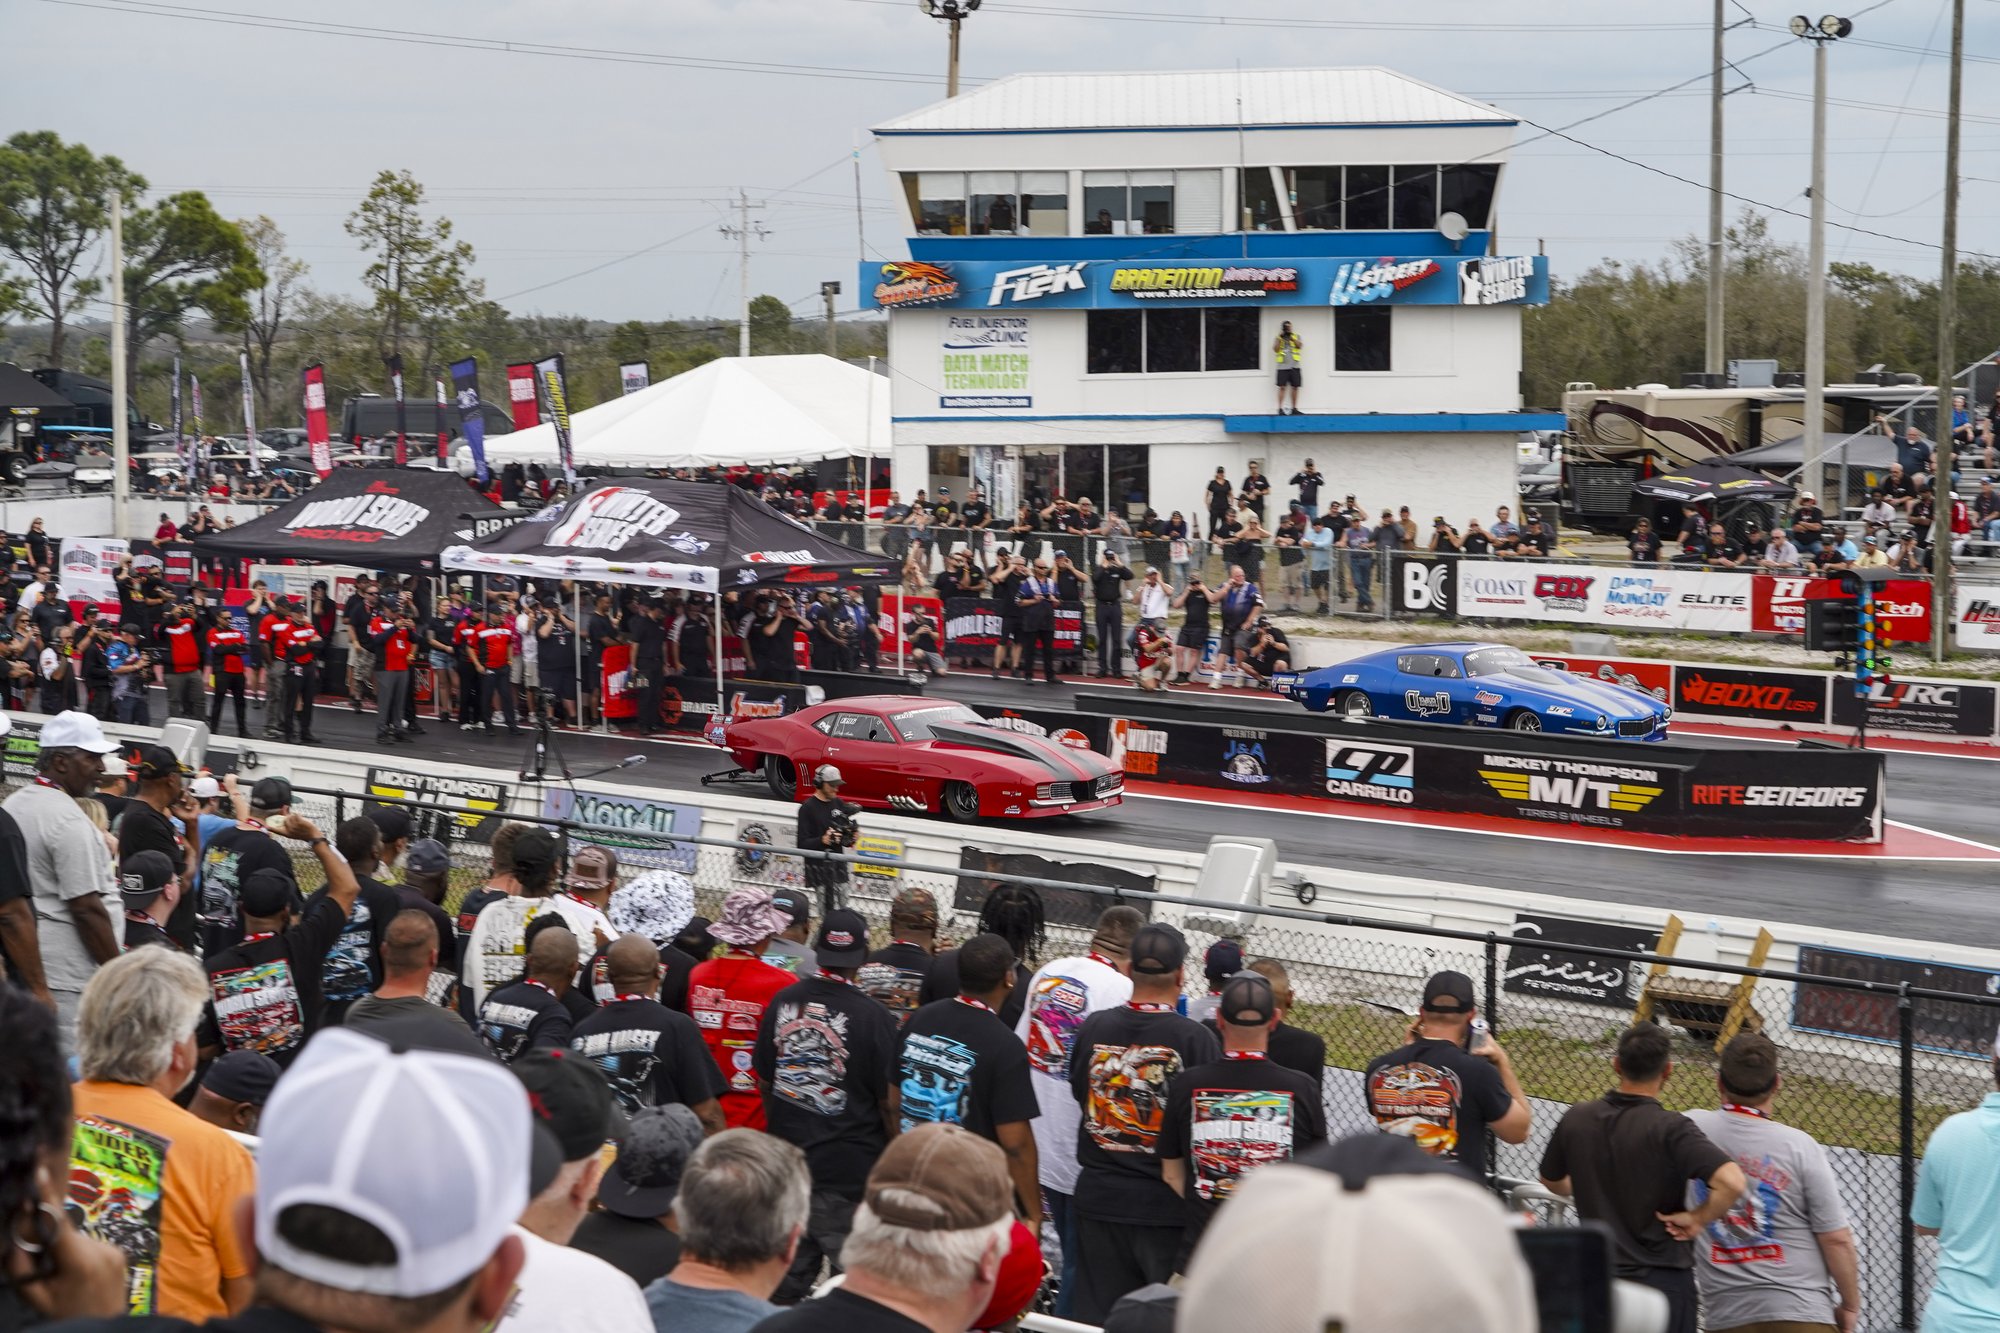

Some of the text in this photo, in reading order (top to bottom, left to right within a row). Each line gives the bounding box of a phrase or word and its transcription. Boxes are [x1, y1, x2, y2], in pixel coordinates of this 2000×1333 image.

[1110, 269, 1225, 290] BRADENTON
[1357, 259, 1433, 287] STREET
[949, 317, 1028, 329] FUEL INJECTOR
[989, 329, 1028, 342] CLINIC
[943, 354, 1029, 373] DATA MATCH
[943, 373, 1028, 390] TECHNOLOGY
[1474, 578, 1528, 596] COAST
[1533, 575, 1596, 601] COX
[1680, 593, 1747, 605] ELITE
[1708, 682, 1817, 712] BOXO USA
[1223, 740, 1268, 766] J&A
[1483, 754, 1659, 783] MICKEY THOMPSON
[374, 769, 501, 800] MICKEY THOMPSON
[1325, 779, 1415, 804] CARRILLO
[1528, 774, 1622, 809] M/T
[1516, 807, 1558, 820] TIRES
[1570, 813, 1623, 827] WHEELS
[1522, 978, 1607, 998] PERFORMANCE
